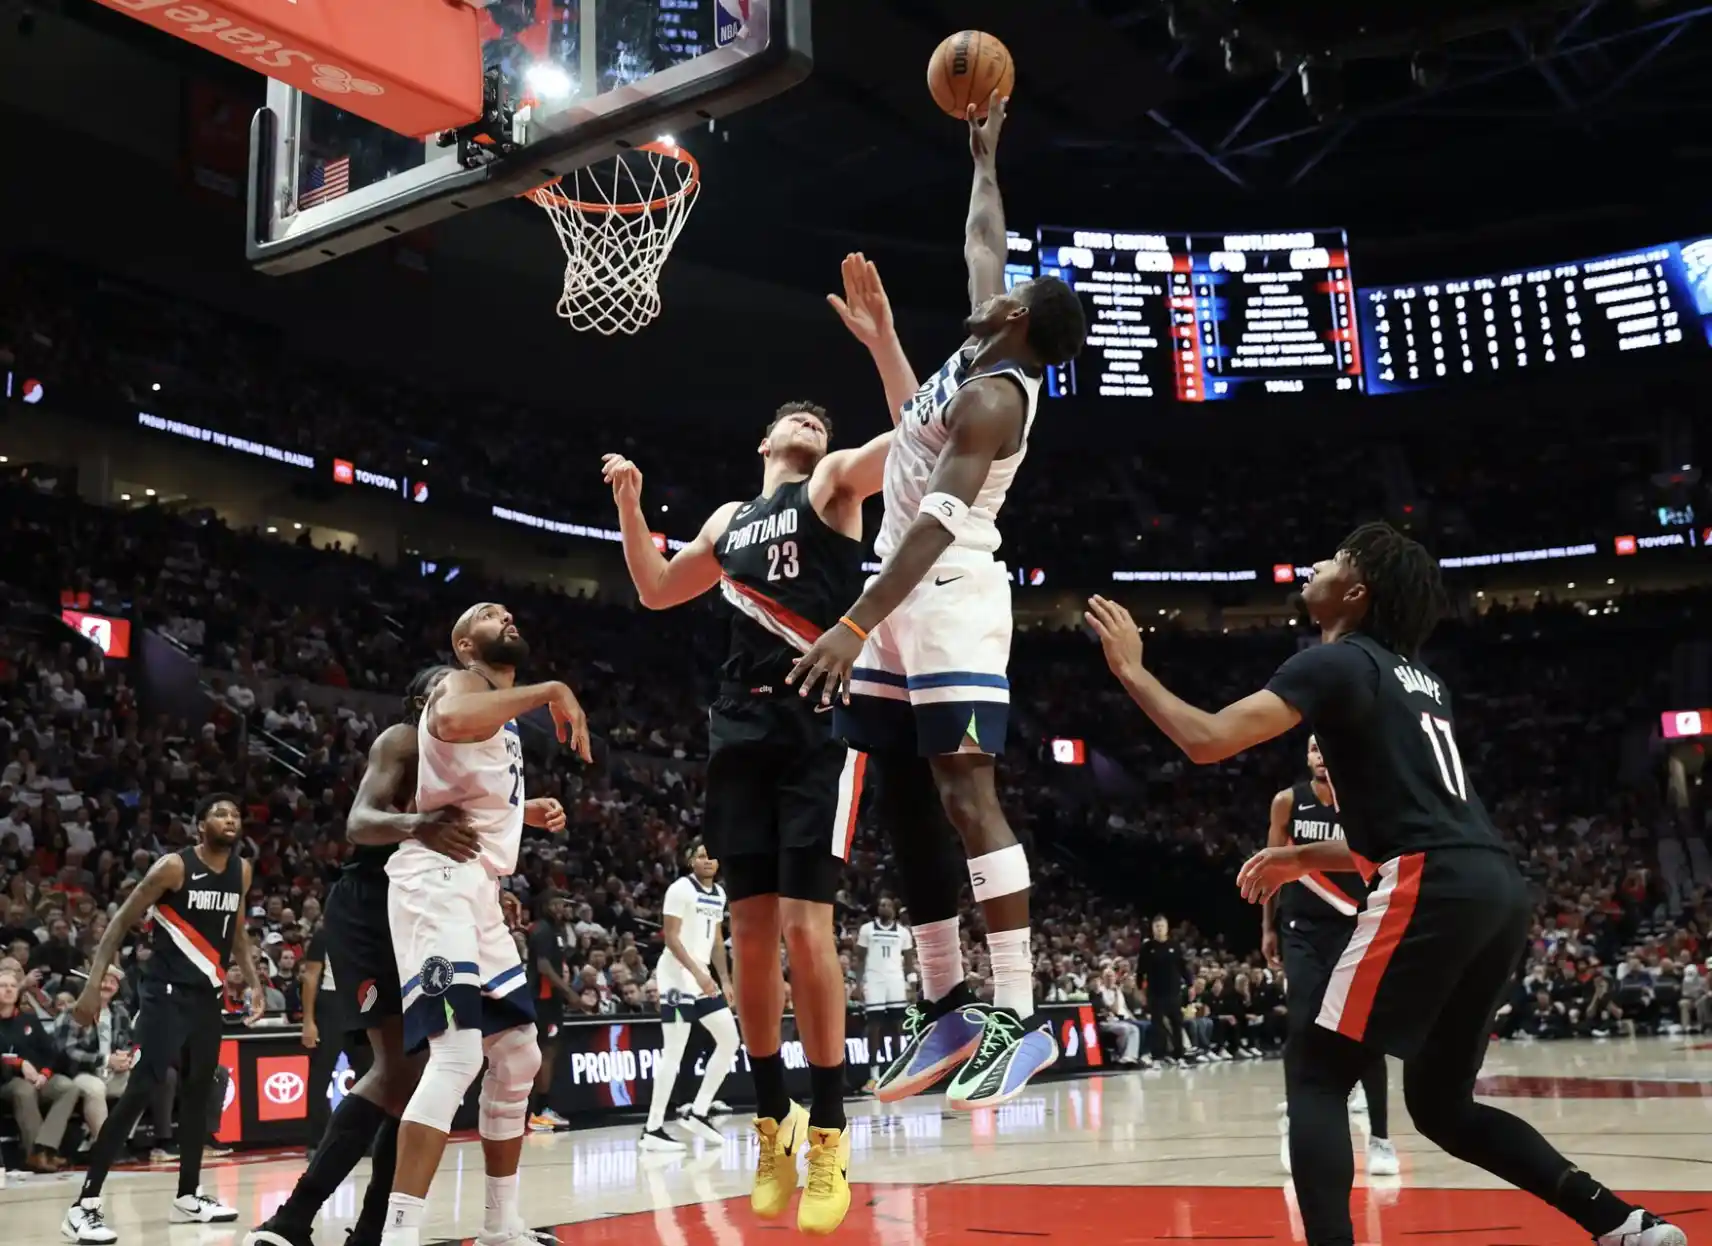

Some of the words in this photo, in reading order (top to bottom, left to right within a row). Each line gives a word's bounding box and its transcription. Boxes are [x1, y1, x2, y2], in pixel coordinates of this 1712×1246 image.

[720, 25, 740, 42] NBA
[138, 412, 166, 431] PROUD
[166, 419, 201, 439] PARTNER
[355, 468, 398, 491] TOYOTA
[939, 500, 956, 517] 5
[725, 507, 799, 554] PORTLAND
[1637, 533, 1685, 549] TOYOTA
[766, 540, 801, 582] 23
[1419, 711, 1468, 802] 17
[971, 871, 987, 887] 5
[187, 889, 240, 913] PORTLAND
[222, 913, 231, 940] 1
[705, 918, 711, 940] 1
[881, 945, 891, 959] 11
[571, 1050, 637, 1085] PROUD
